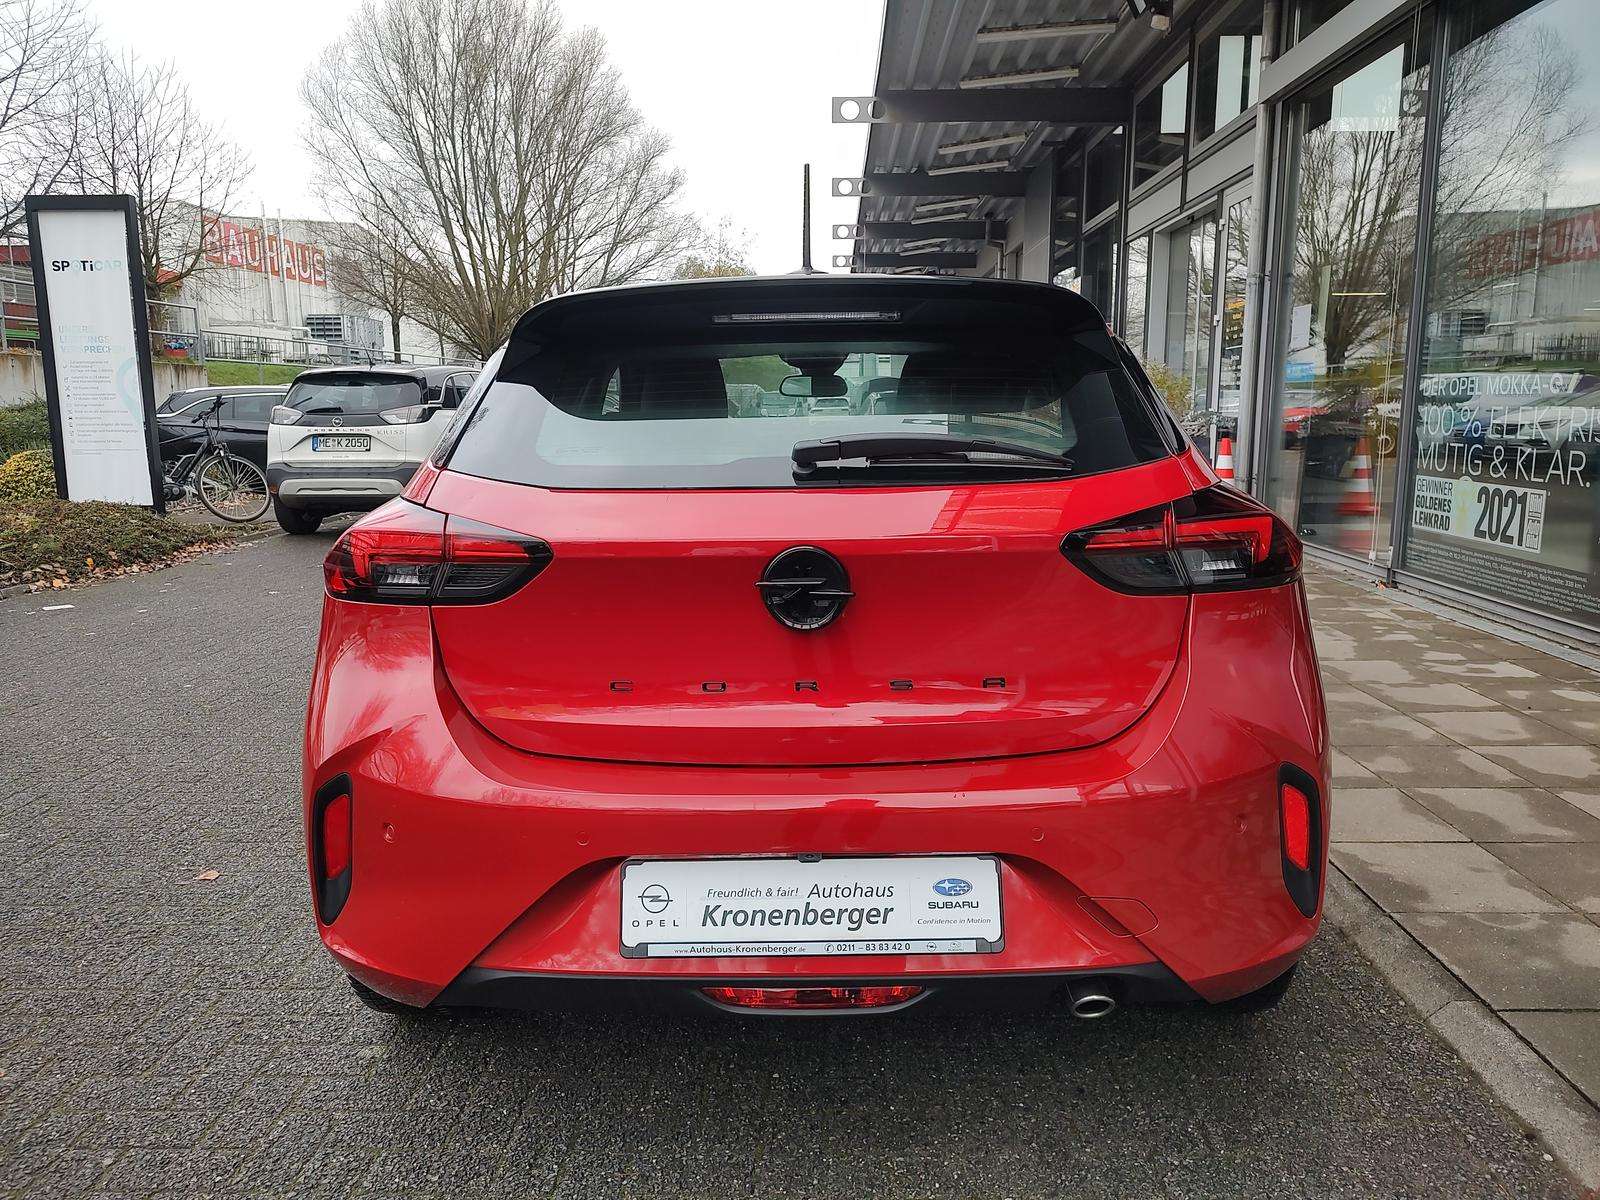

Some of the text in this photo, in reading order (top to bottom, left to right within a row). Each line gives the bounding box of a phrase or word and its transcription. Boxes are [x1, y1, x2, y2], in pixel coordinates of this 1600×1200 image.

[203, 217, 325, 284] BAUHAUS
[1423, 378, 1447, 396] DER
[1450, 376, 1482, 396] OPEL
[1421, 405, 1600, 443] 100 % ELEKTRI
[319, 438, 369, 448] ME K 2050
[1416, 440, 1591, 488] MUTIG & KLAR.
[1416, 479, 1453, 496] GEWINNER
[1415, 494, 1452, 513] GOLDENES
[1414, 510, 1451, 531] LENKRAD
[1474, 486, 1528, 547] 2021
[610, 677, 1006, 693] CORSA
[707, 887, 799, 898] Freundlich & fair!
[807, 882, 894, 899] Autohaus
[928, 901, 979, 910] SUBARU
[632, 919, 679, 928] OPEL
[702, 902, 894, 932] Kronenberger
[836, 943, 855, 952] 0211
[865, 943, 877, 951] 83
[879, 943, 890, 951] 83
[892, 942, 903, 951] 42
[904, 942, 911, 951] 0
